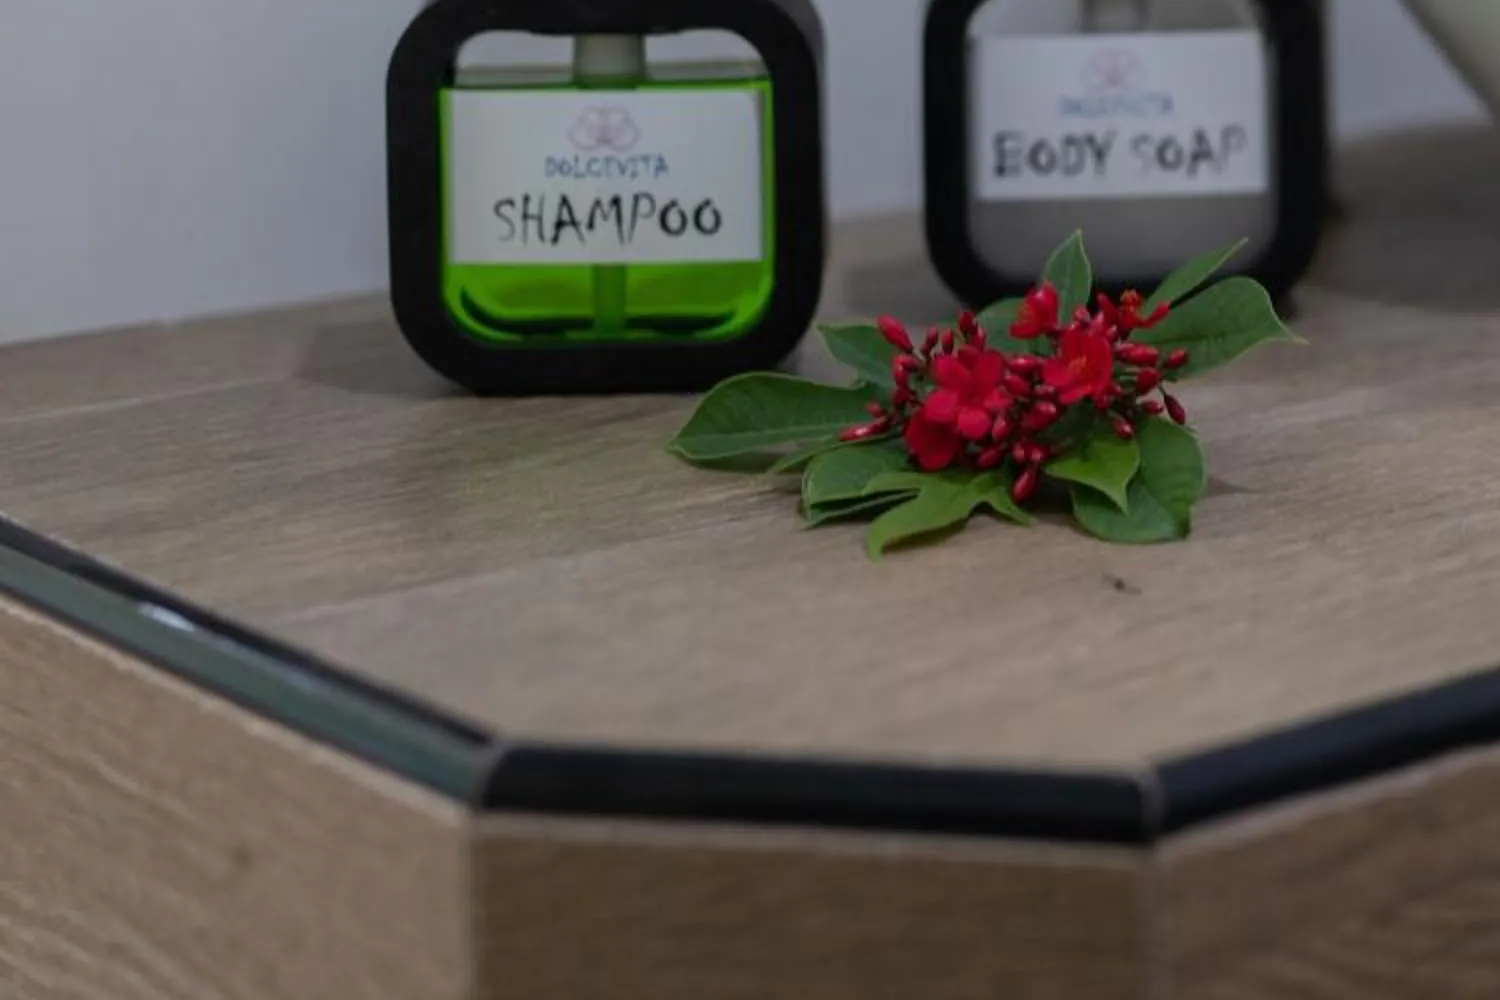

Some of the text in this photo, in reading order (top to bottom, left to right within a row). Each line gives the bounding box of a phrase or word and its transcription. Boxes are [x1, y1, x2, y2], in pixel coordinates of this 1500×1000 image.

[993, 124, 1248, 178] BODY SOAP
[493, 191, 722, 246] SHAMPOO
